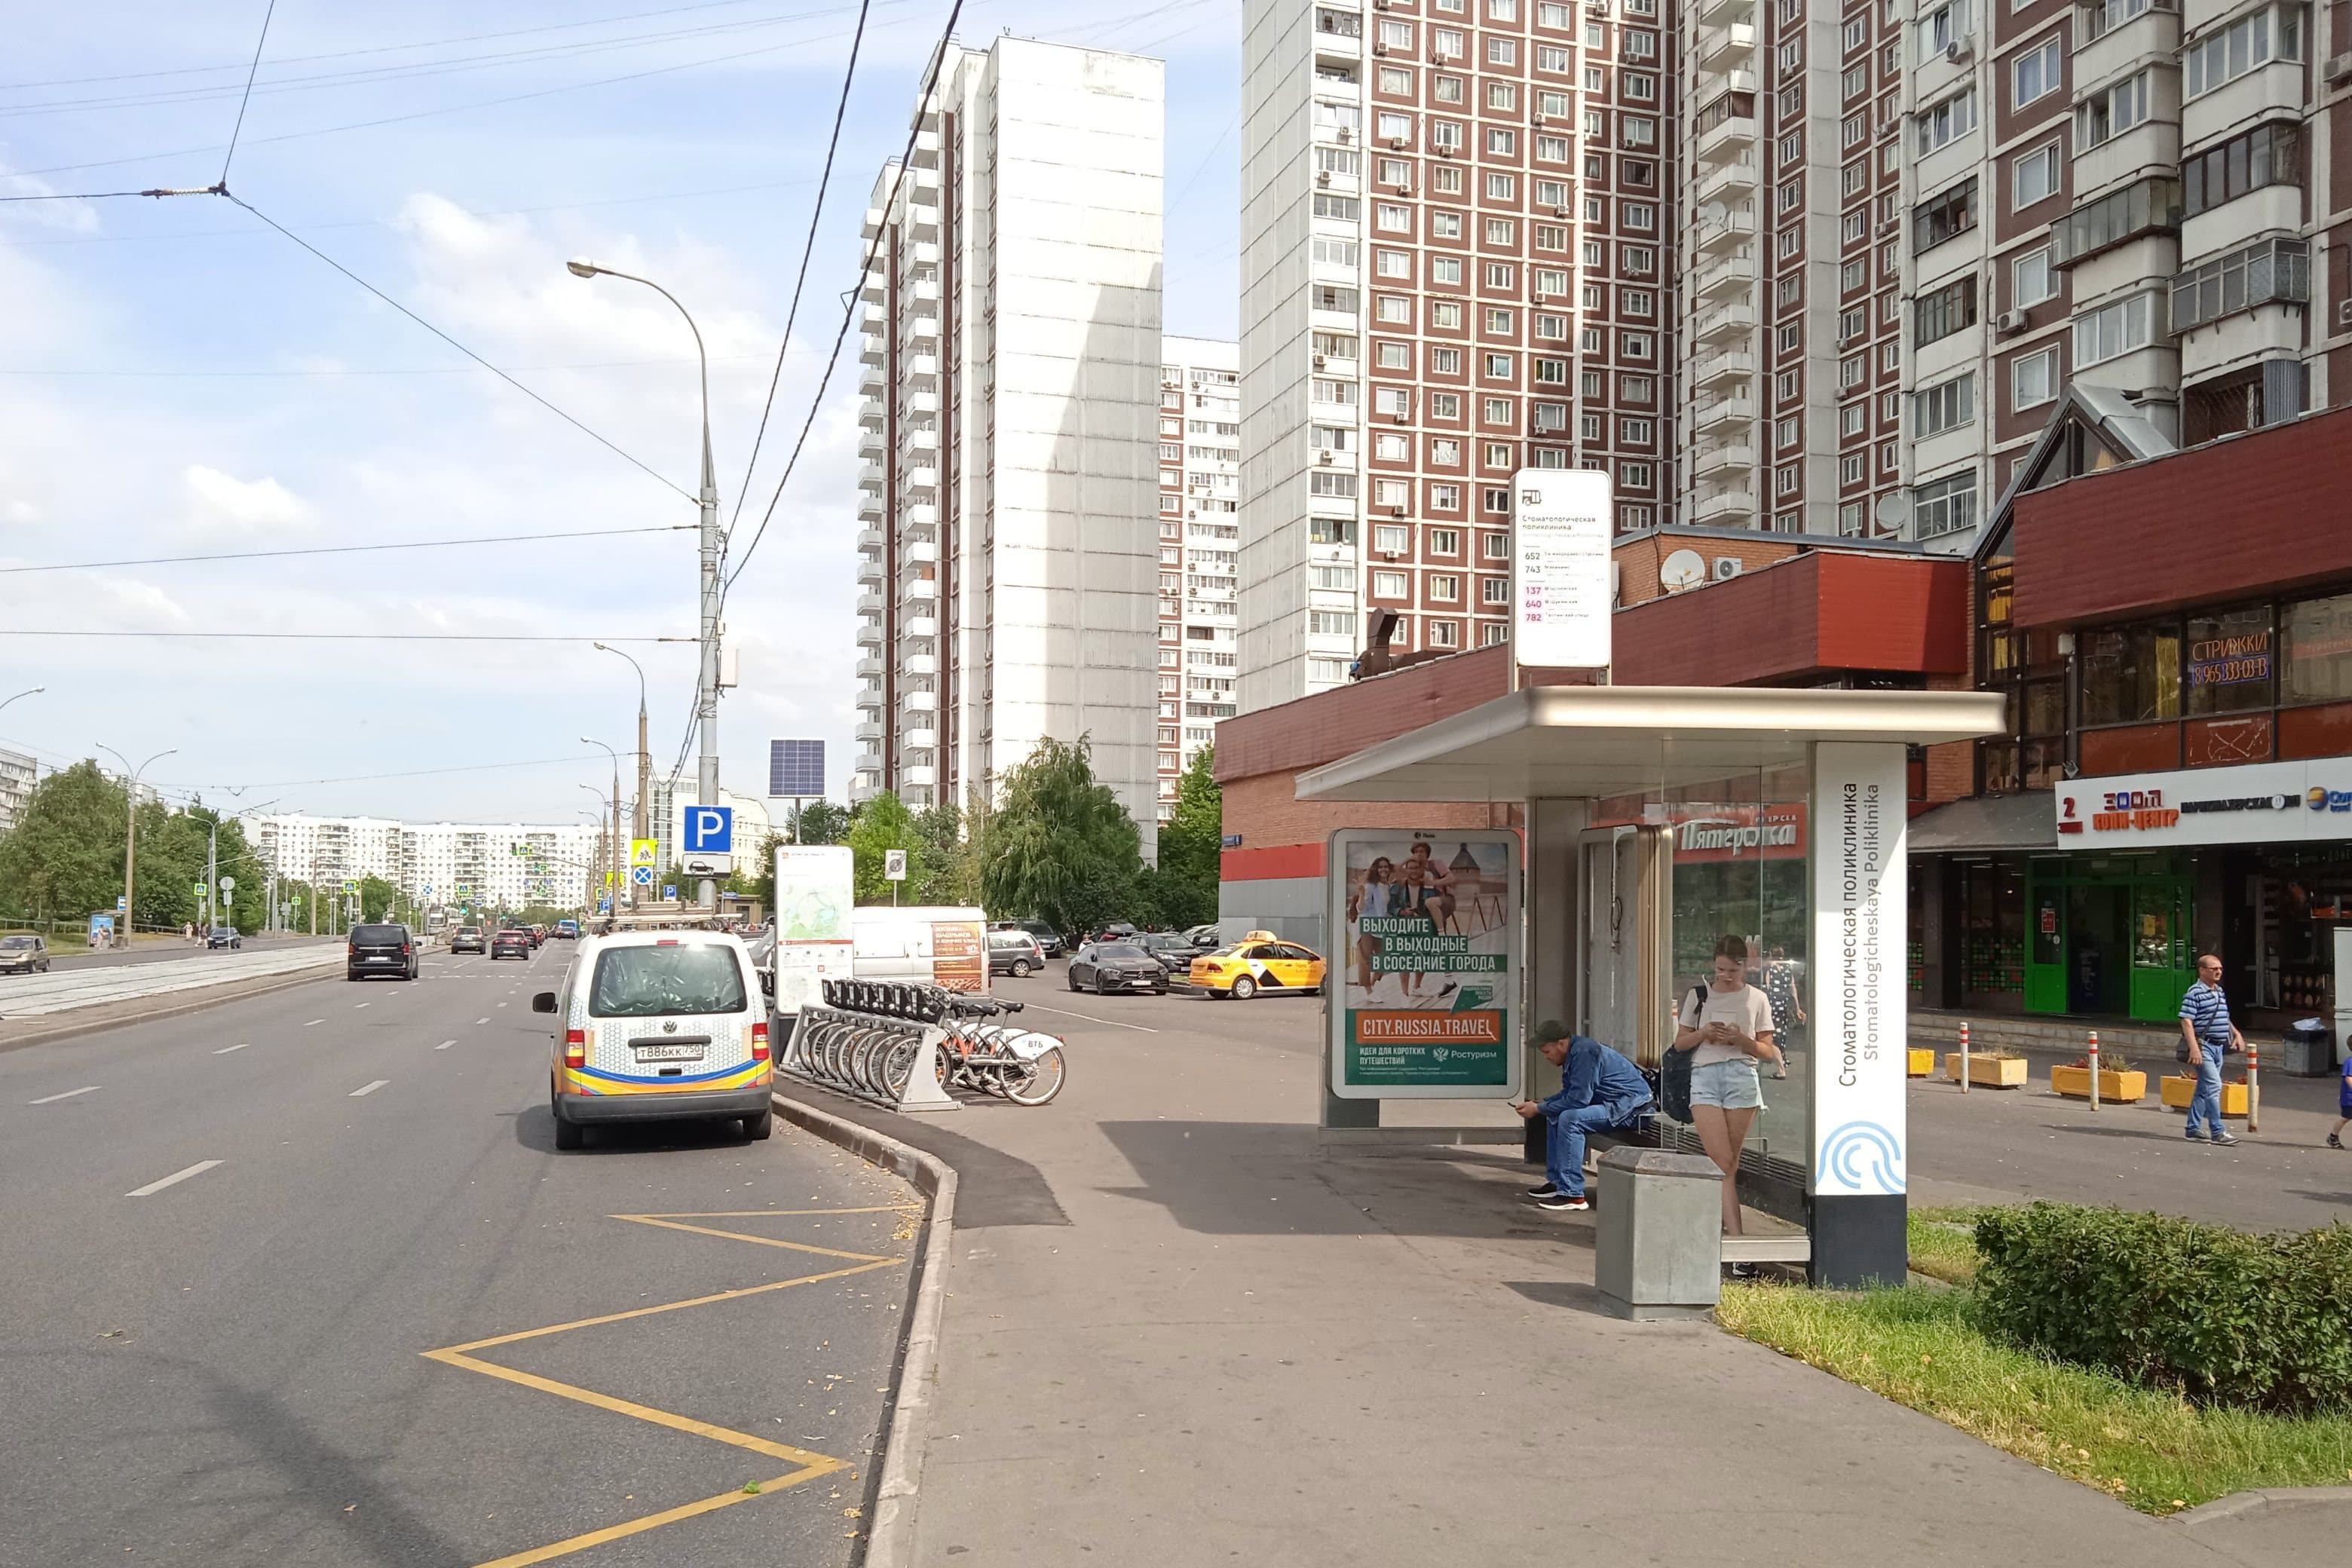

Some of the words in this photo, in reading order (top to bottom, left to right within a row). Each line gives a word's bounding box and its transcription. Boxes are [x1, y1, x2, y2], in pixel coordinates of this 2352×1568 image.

[1525, 552, 1541, 560] 652
[1525, 565, 1541, 574] 743
[1526, 586, 1542, 595] 137
[1525, 600, 1542, 608] 640
[1526, 614, 1542, 622] 782
[2192, 632, 2268, 661] СТРИЖКИ
[2063, 797, 2075, 818] 2
[697, 810, 724, 847] P
[1863, 784, 1879, 873] Poliklinika
[1843, 783, 1857, 902] поликлиника
[1362, 917, 1429, 934] ВЫХОДИТЕ
[1386, 937, 1393, 951] В
[1396, 937, 1466, 953] ВЫХОДНЫЕ
[1372, 956, 1380, 970] В
[1383, 956, 1446, 972] СОСЕДНИЕ
[1449, 956, 1496, 972] ГОРОДА
[1863, 877, 1882, 1060] Stomatologicheskaya
[1839, 907, 1857, 1087] Стоматологическая
[1363, 1018, 1493, 1036] CITY.RUSSIA.TRAVEL
[684, 1044, 700, 1053] 750
[1359, 1046, 1377, 1055] ИДЕИ
[1378, 1046, 1392, 1055] ДЛЯ
[1393, 1046, 1426, 1055] КОРОТКИХ
[1451, 1050, 1497, 1061] Ростуризм
[1359, 1055, 1405, 1065] ПУТЕШЕСТВИЙ
